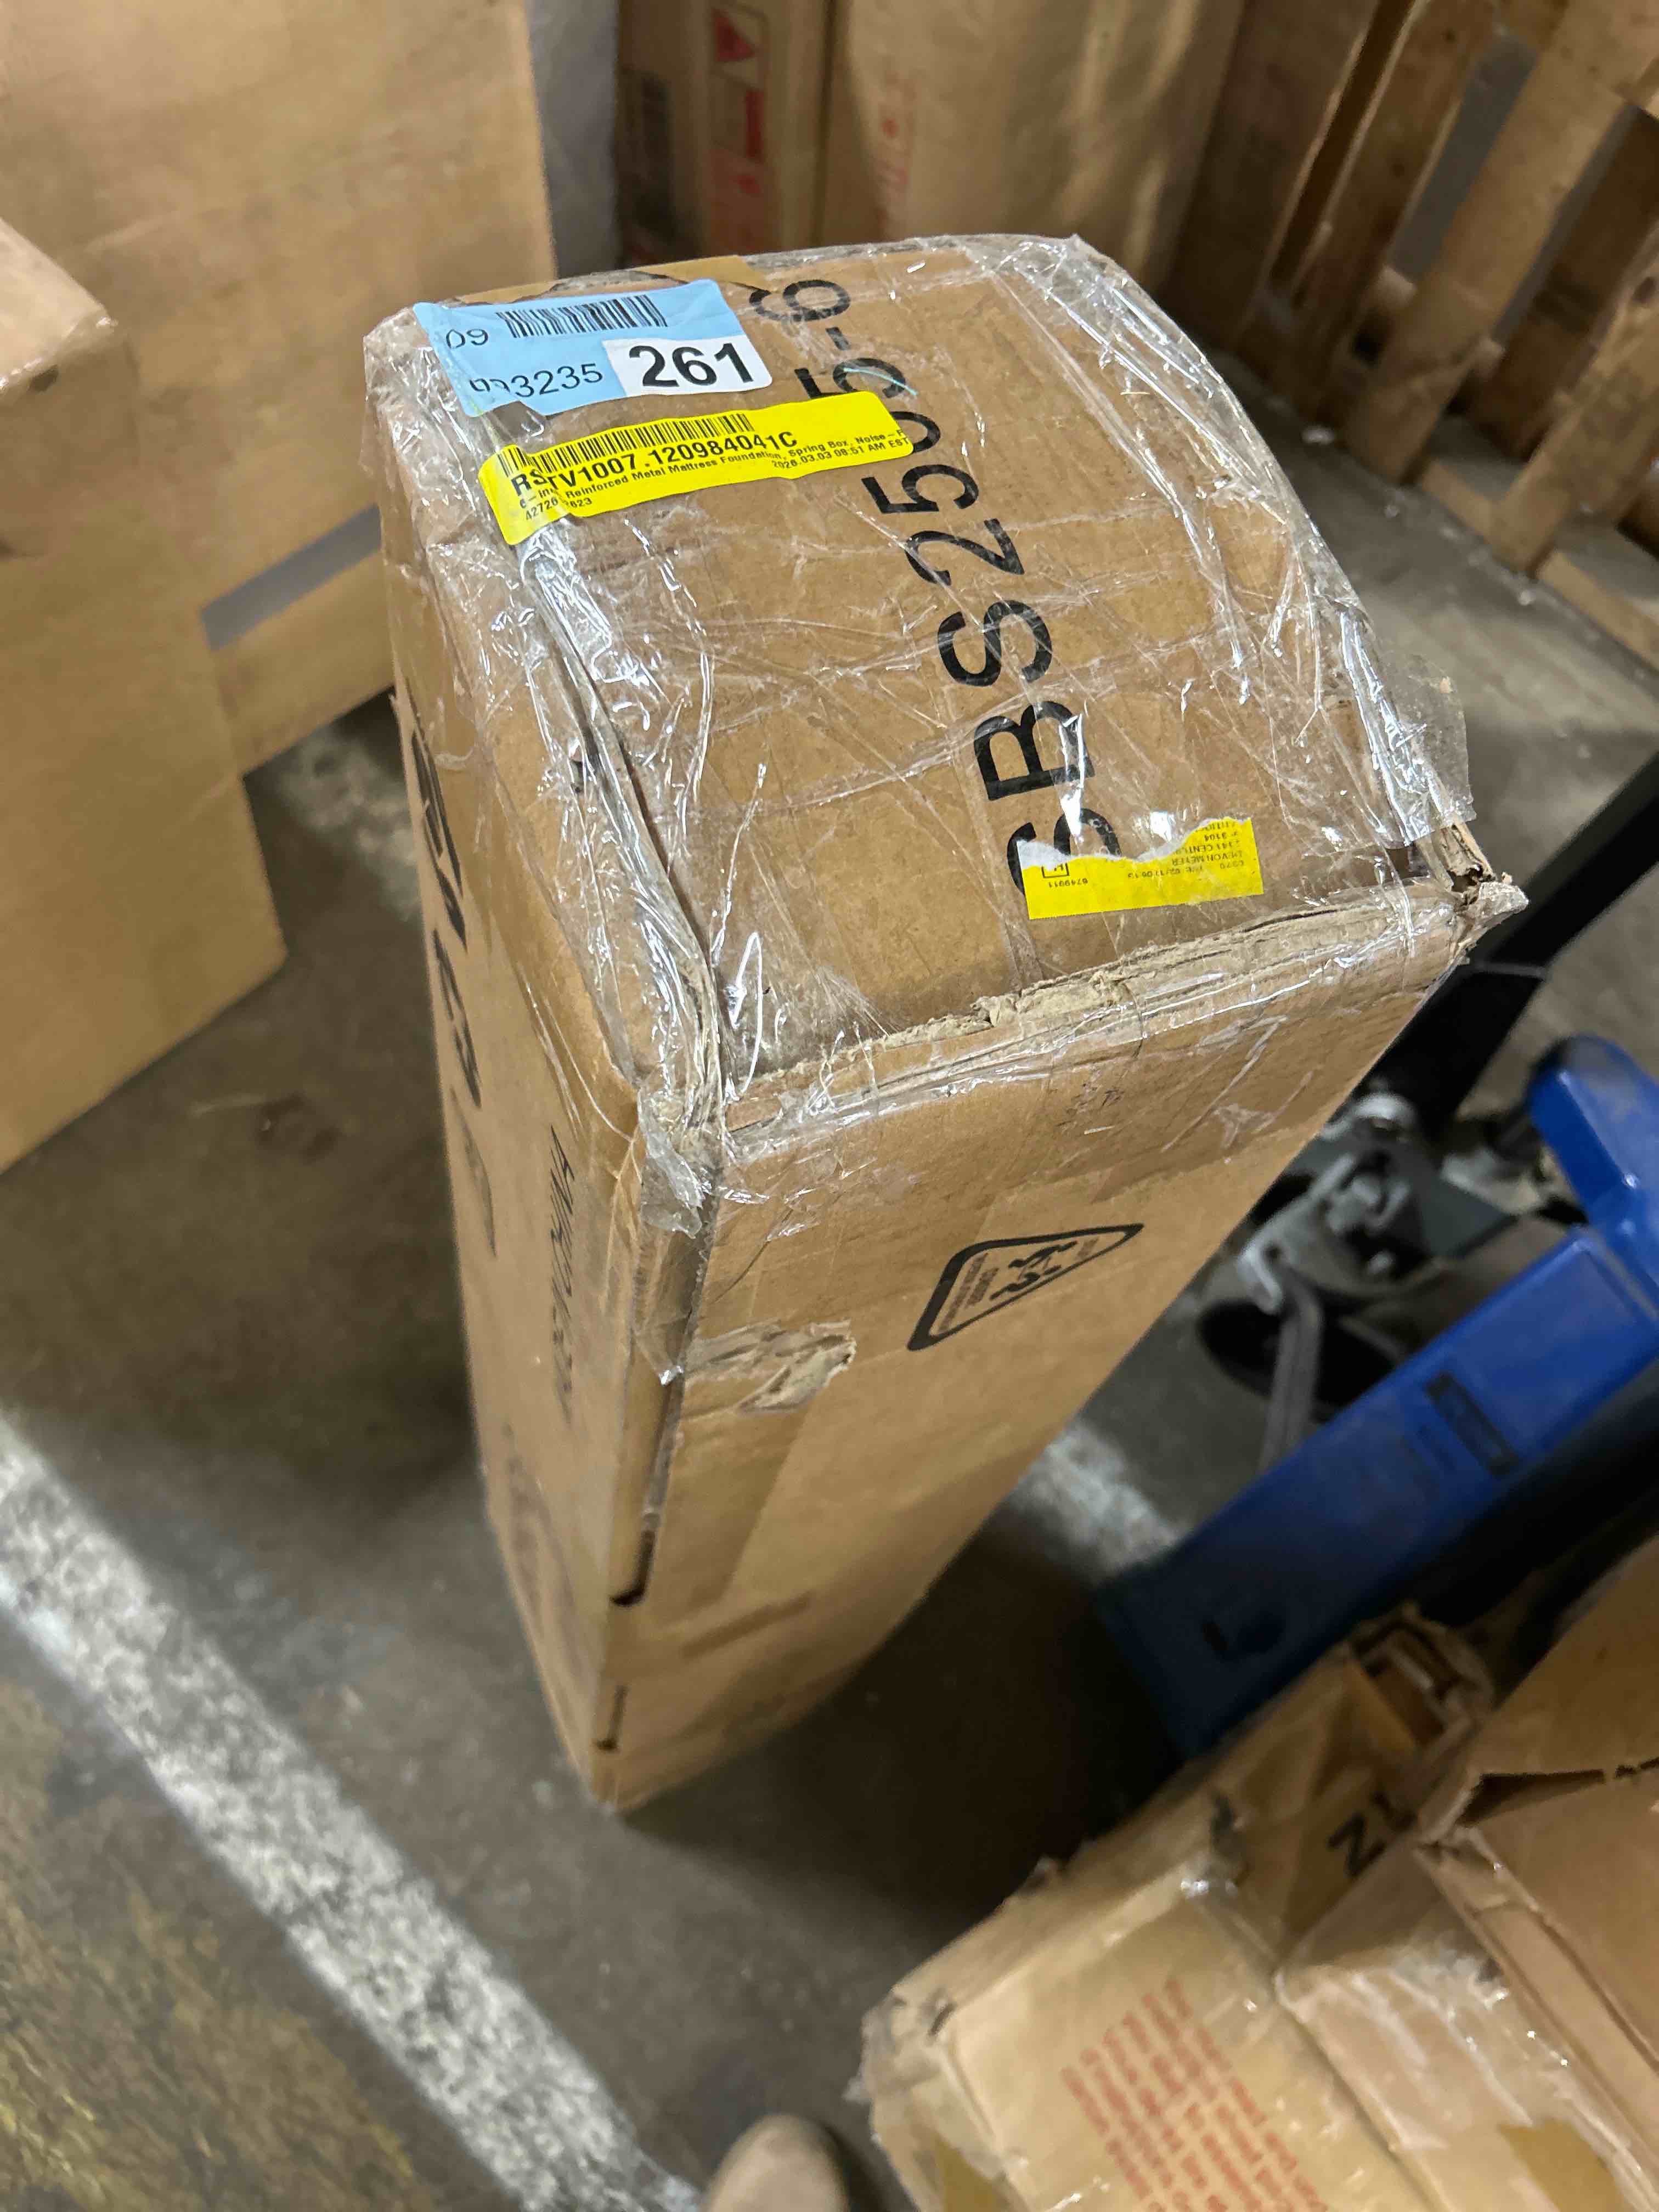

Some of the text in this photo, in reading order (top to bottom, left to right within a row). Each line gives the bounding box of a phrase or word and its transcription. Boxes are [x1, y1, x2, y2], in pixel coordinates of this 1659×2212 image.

[629, 343, 754, 387] 261
[834, 447, 864, 456] 08:51
[868, 442, 885, 452] AM
[888, 437, 909, 448] EST
[566, 476, 629, 499] Reinforced
[631, 468, 665, 481] Metal
[668, 459, 717, 473] Mattress
[788, 443, 826, 457] Spring
